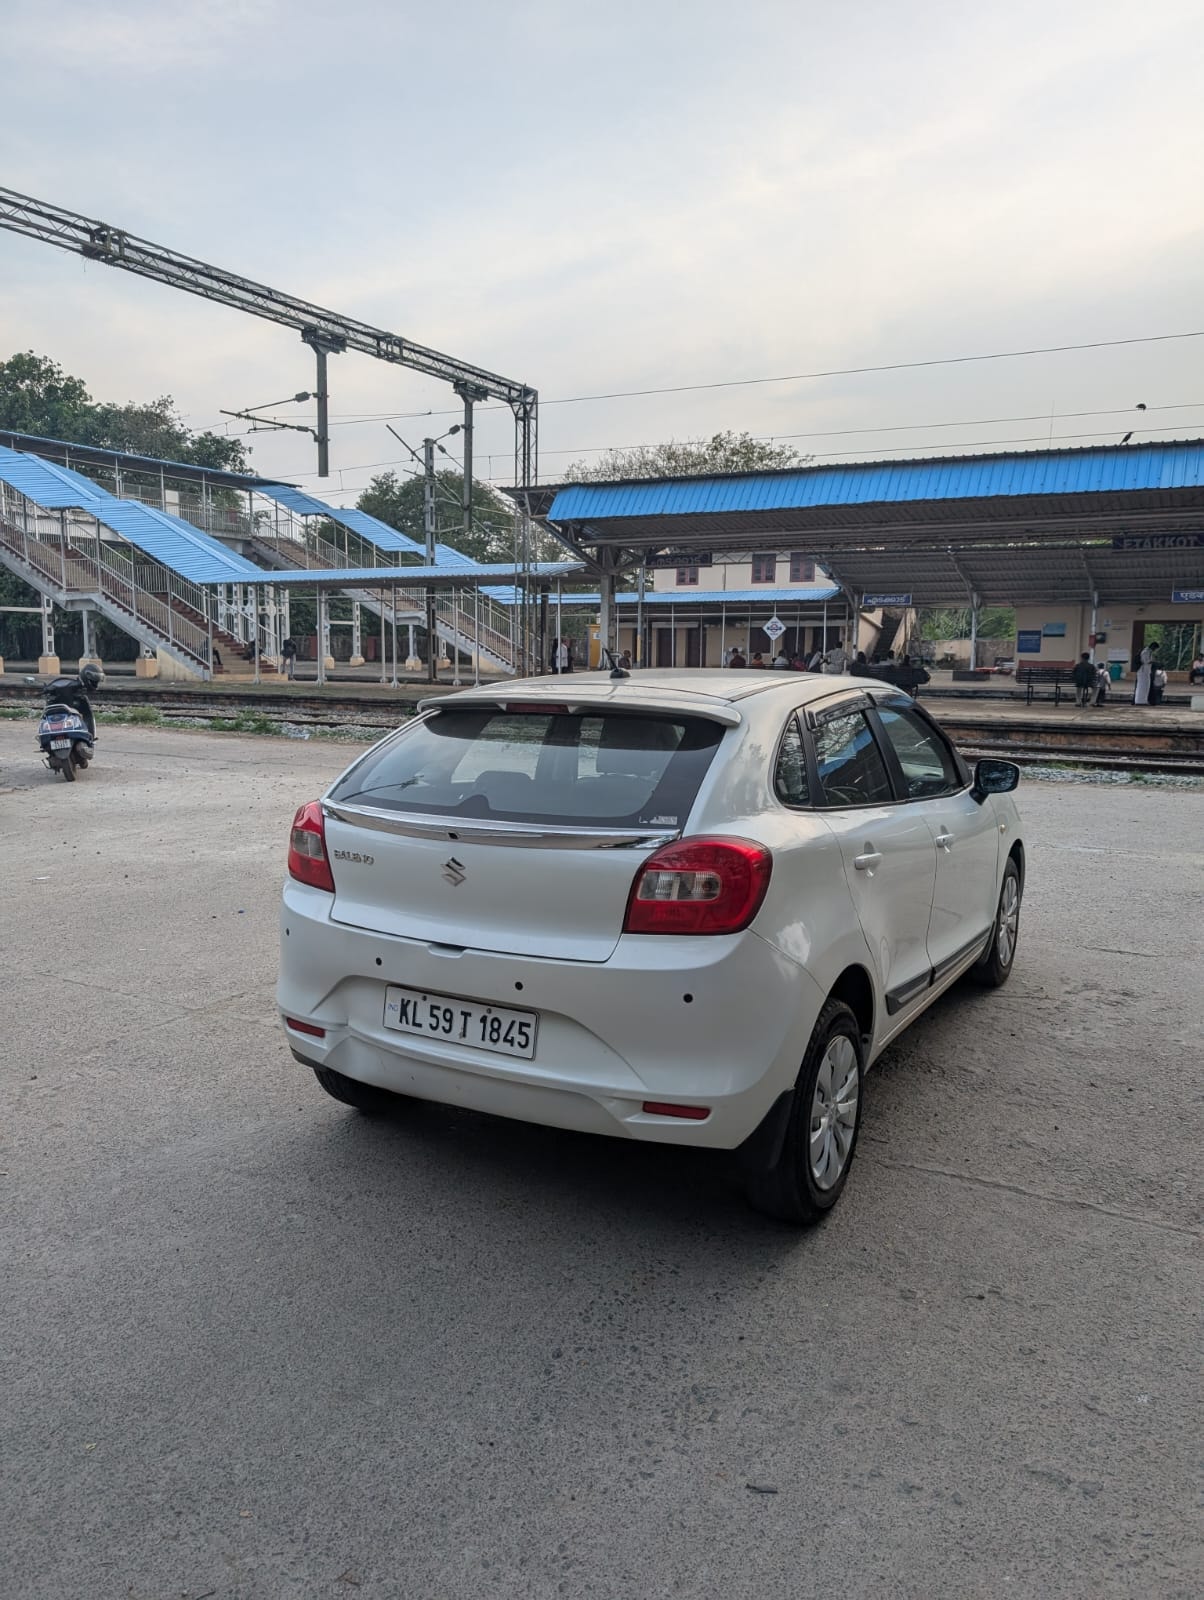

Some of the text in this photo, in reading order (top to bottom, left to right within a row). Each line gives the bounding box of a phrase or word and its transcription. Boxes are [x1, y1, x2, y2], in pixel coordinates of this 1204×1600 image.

[1123, 536, 1198, 549] ETAKKOT
[399, 998, 531, 1049] KL 59 T 1845
